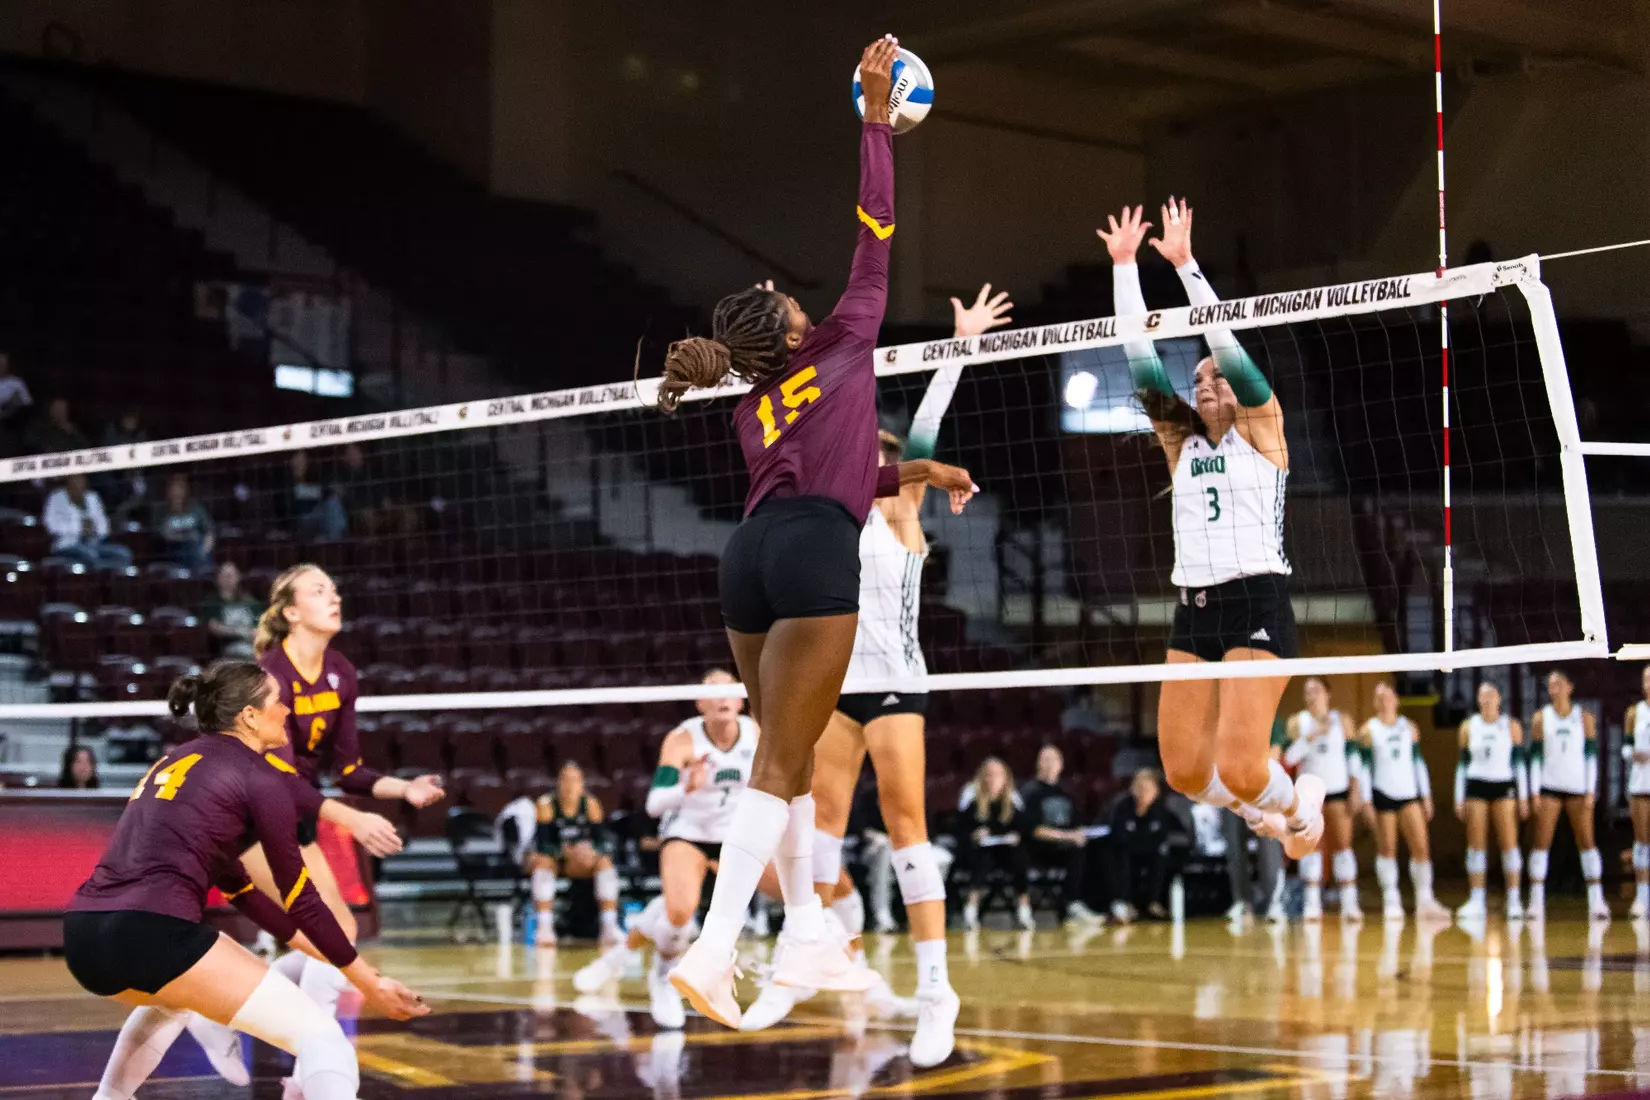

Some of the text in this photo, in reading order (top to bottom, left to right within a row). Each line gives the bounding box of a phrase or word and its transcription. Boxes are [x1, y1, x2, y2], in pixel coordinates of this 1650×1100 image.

[888, 78, 908, 117] molte
[1189, 277, 1411, 327] CENTRAL MICHIGAN VOLLEYBALL
[922, 319, 1117, 362] CENTRAL MICHIGAN VOLLEYBALL
[756, 365, 821, 448] 15
[1206, 487, 1221, 522] 3
[129, 752, 203, 801] 14
